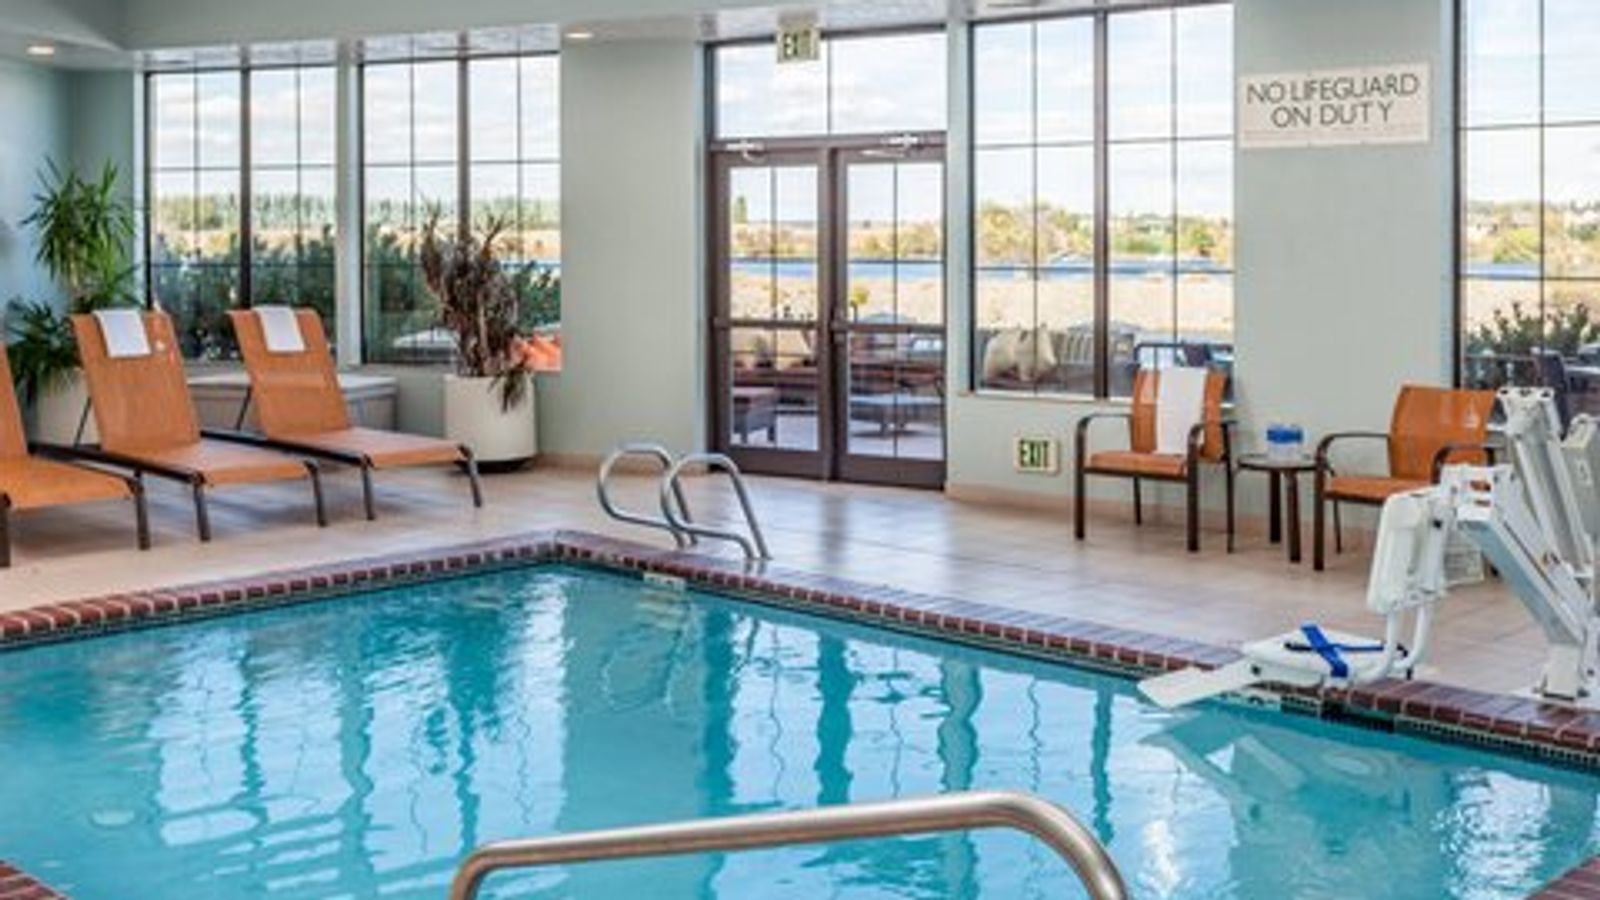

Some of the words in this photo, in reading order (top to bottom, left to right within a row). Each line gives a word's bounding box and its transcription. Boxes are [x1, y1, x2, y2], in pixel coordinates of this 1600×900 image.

[782, 30, 812, 59] EXIT
[1246, 80, 1285, 104] NO
[1290, 73, 1420, 101] LIFEGUARD
[1271, 105, 1312, 128] ON
[1320, 101, 1394, 125] DUTY
[1019, 439, 1049, 469] EXIT
